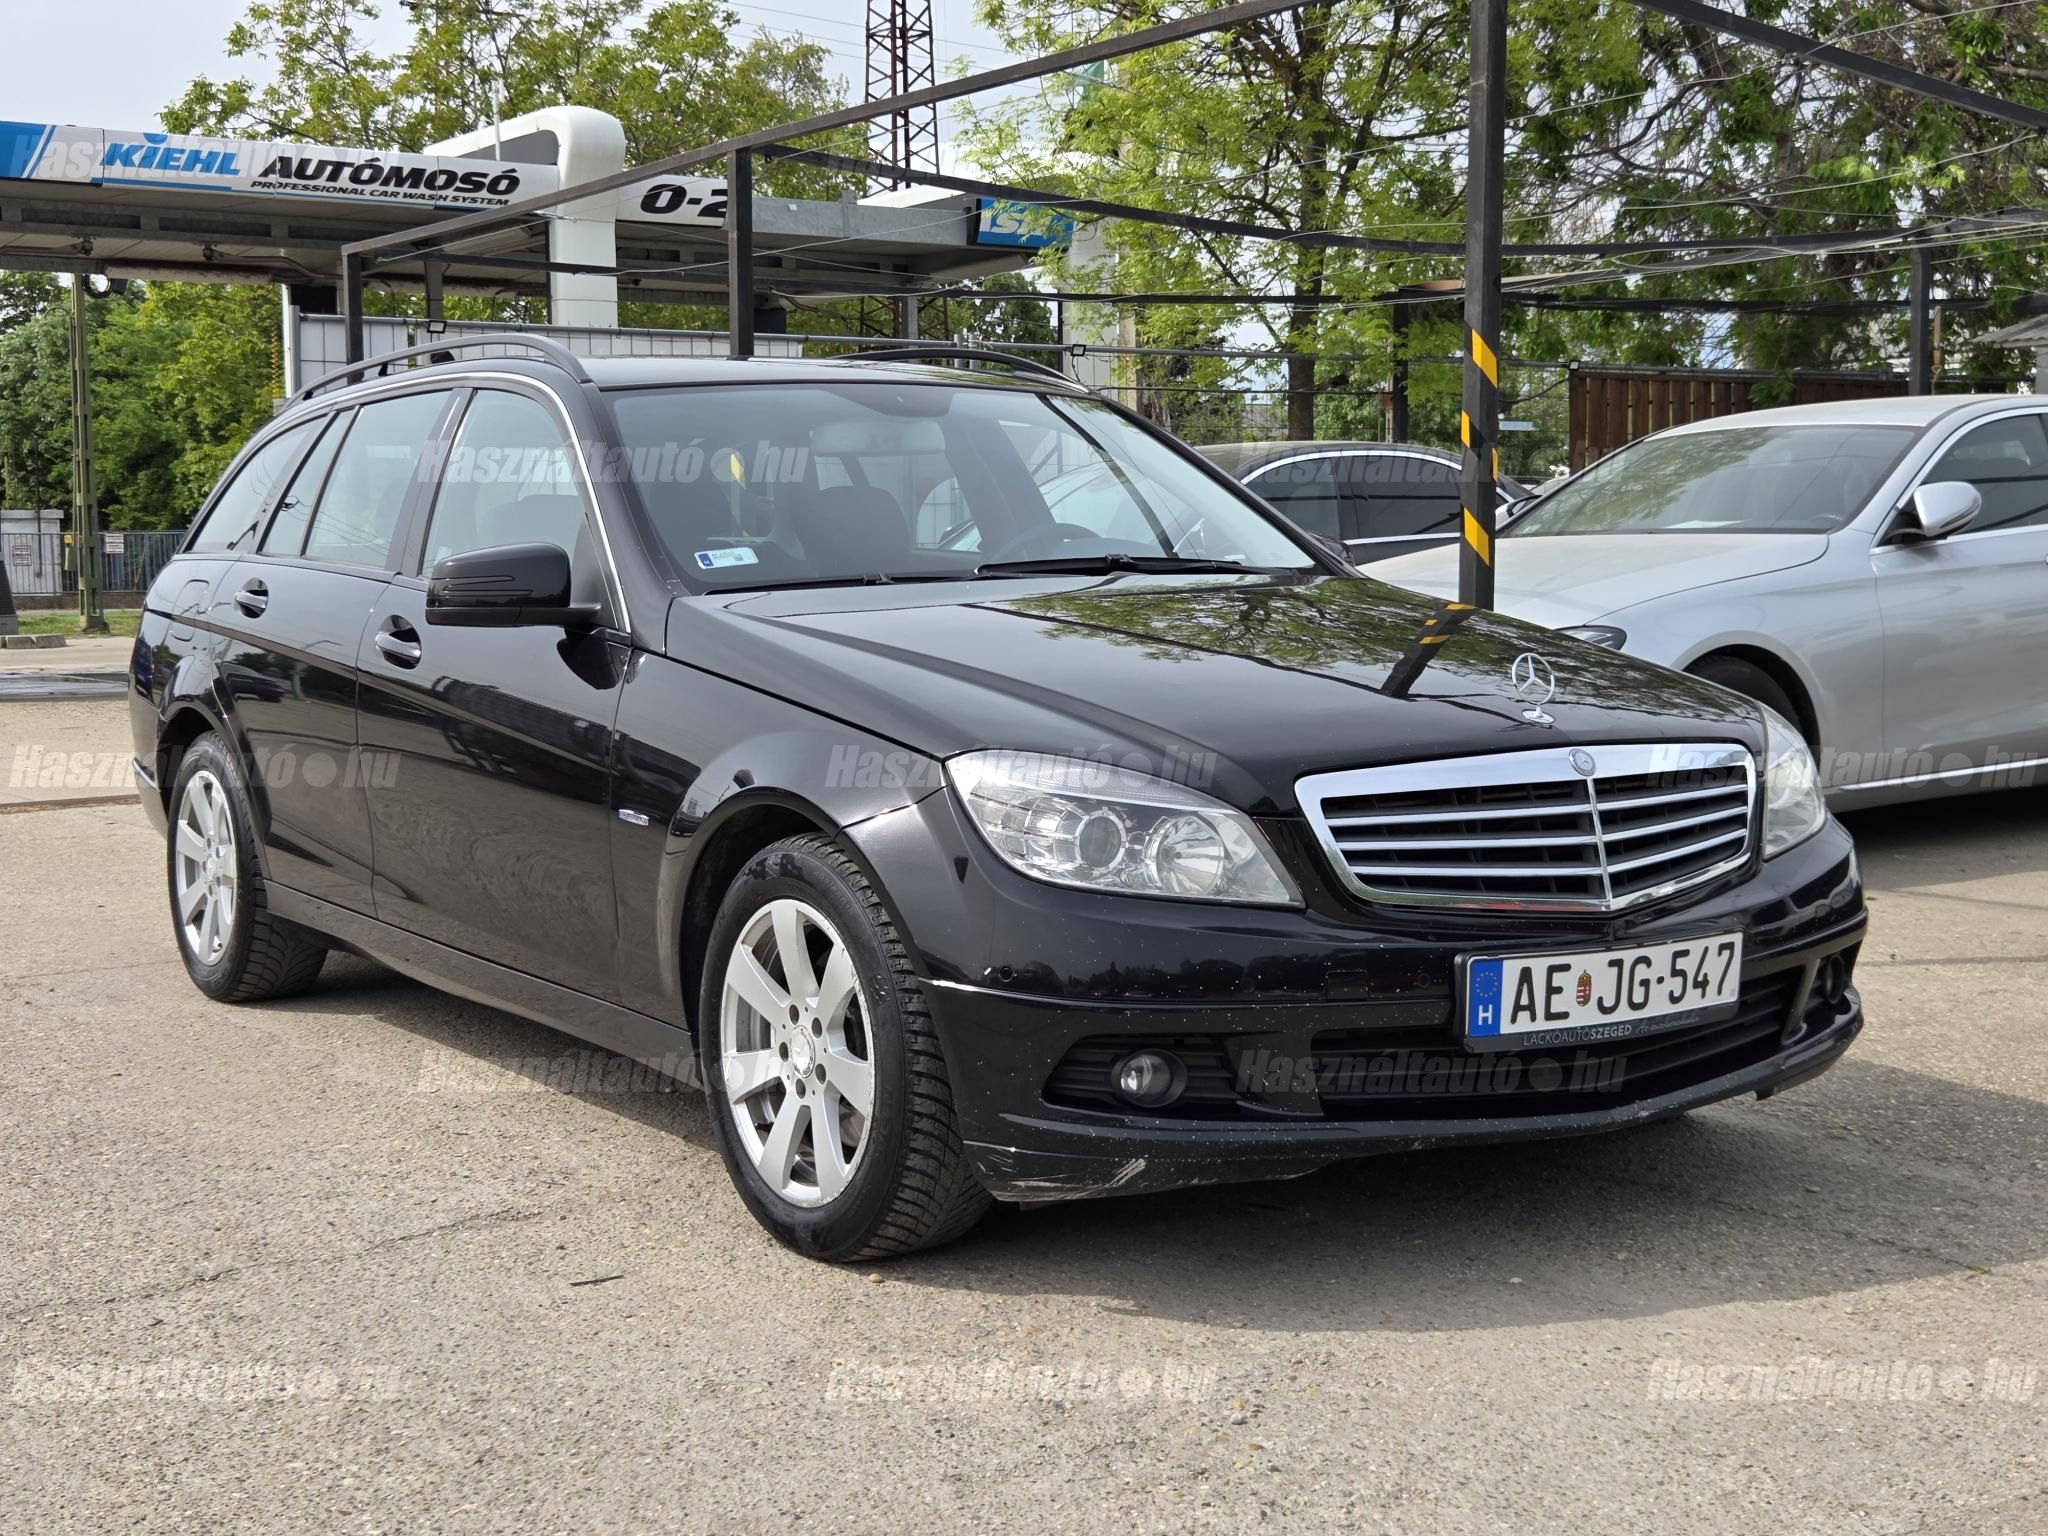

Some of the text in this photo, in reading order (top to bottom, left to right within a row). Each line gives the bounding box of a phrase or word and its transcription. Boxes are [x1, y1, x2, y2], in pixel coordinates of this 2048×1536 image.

[251, 181, 510, 206] PROFESSIONAL CAR WASH SYSTEM
[258, 156, 520, 196] AUTÓMOSÓ
[1477, 1004, 1493, 1026] H
[1510, 963, 1572, 1025] AE
